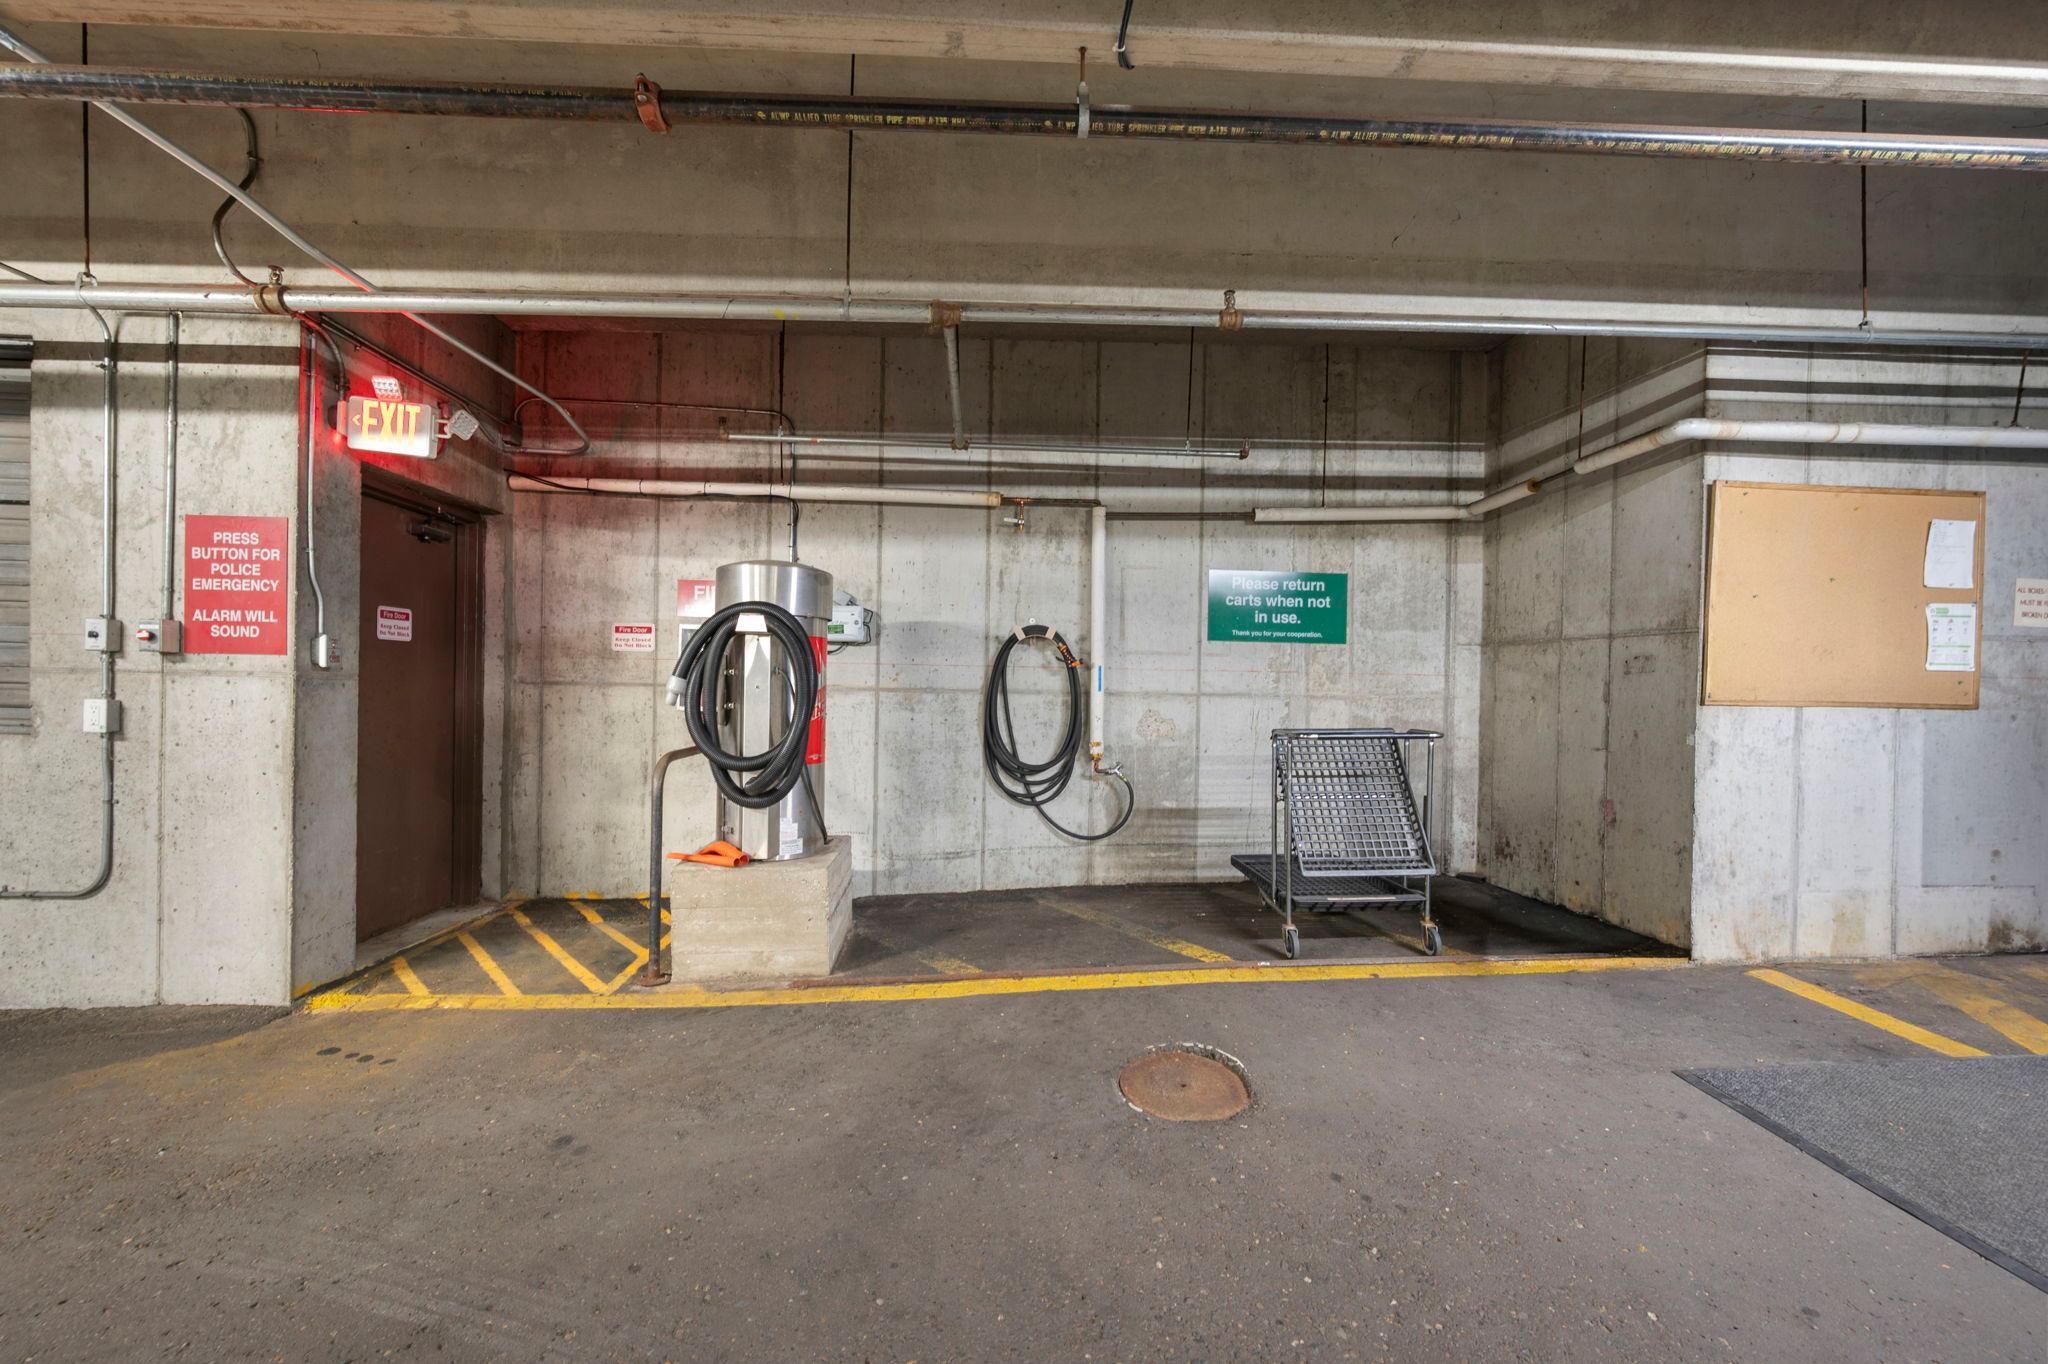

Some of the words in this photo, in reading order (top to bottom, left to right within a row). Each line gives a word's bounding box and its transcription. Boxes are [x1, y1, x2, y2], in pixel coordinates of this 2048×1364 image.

[361, 399, 421, 443] EXIT
[213, 532, 260, 545] PRESS
[191, 547, 248, 560] BUTTON
[252, 549, 280, 561] FOR
[210, 563, 261, 576] POLICE
[191, 578, 280, 592] EMERGENCY
[1232, 576, 1279, 591] Please
[1283, 579, 1325, 592] return
[694, 585, 716, 601] FI
[1225, 594, 1262, 607] carts
[1265, 595, 1304, 608] when
[1307, 596, 1331, 609] not
[192, 609, 241, 622] ALARM
[245, 610, 278, 623] WILL
[1254, 610, 1268, 624] in
[1271, 613, 1301, 625] use.
[210, 625, 260, 638] SOUND
[1232, 629, 1250, 637] Thank
[1251, 630, 1262, 638] you
[1272, 631, 1286, 639] your
